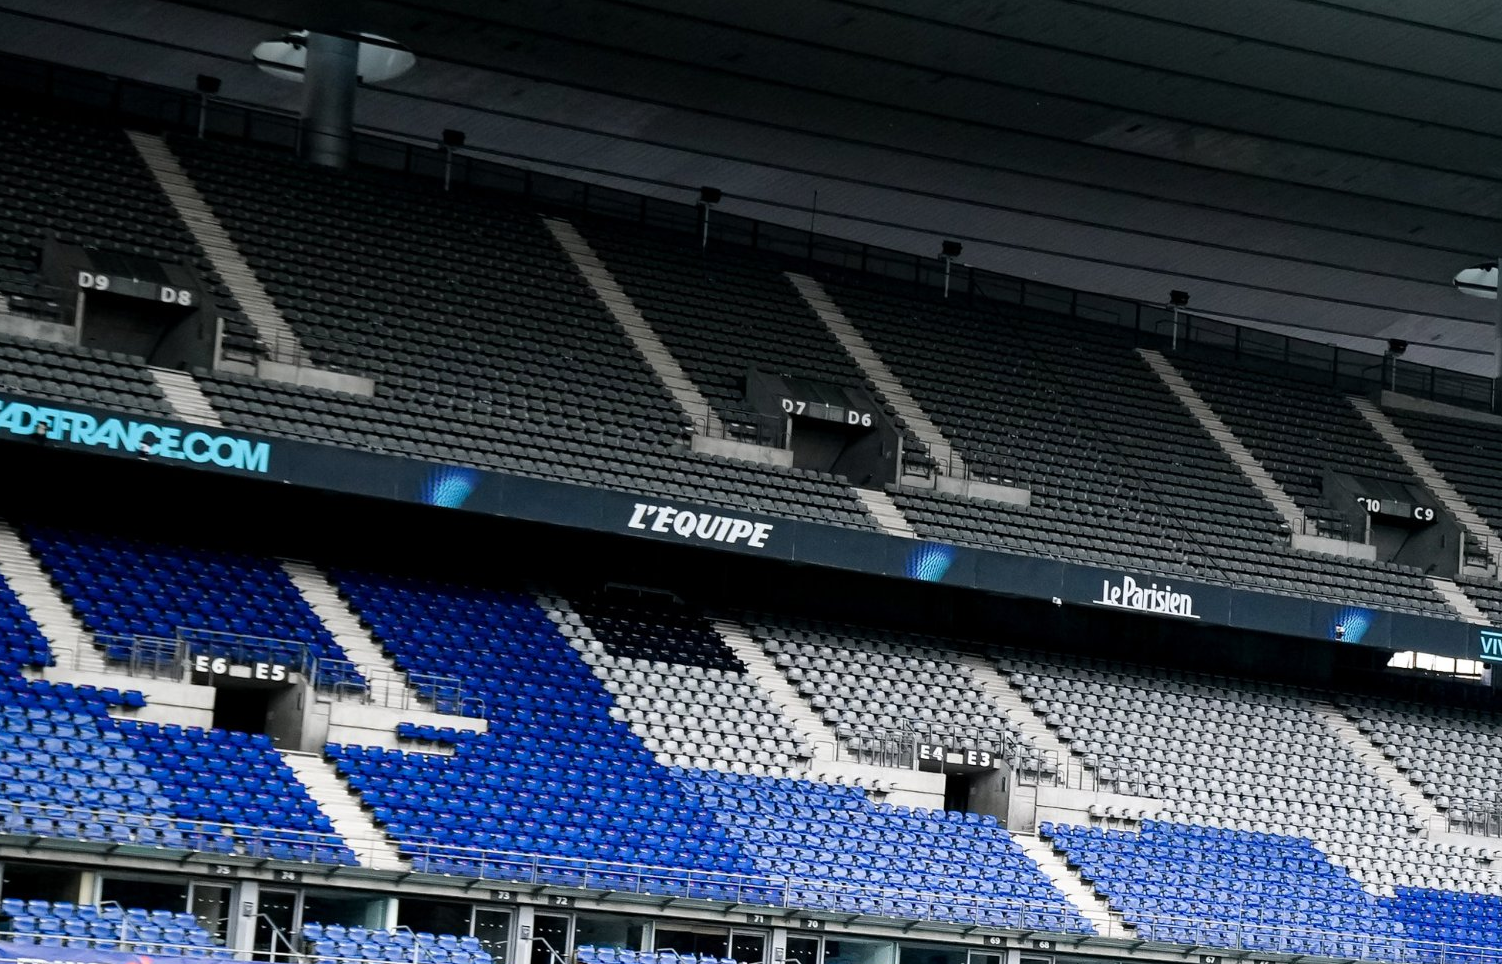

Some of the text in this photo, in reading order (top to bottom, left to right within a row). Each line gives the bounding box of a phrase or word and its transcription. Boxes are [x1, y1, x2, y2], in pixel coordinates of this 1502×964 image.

[78, 271, 192, 306] D9 D8
[781, 398, 872, 427] D7 D6
[1414, 507, 1434, 521] C9
[1103, 575, 1193, 615] Le Parisien
[195, 655, 286, 681] E6 E5
[920, 744, 990, 767] E4 E3
[498, 891, 510, 900] 73
[555, 896, 567, 905] 72
[753, 915, 763, 923] 71
[807, 919, 818, 928] 70
[990, 936, 1000, 945] 69
[1039, 940, 1050, 949] 68
[1205, 956, 1215, 964] 67
